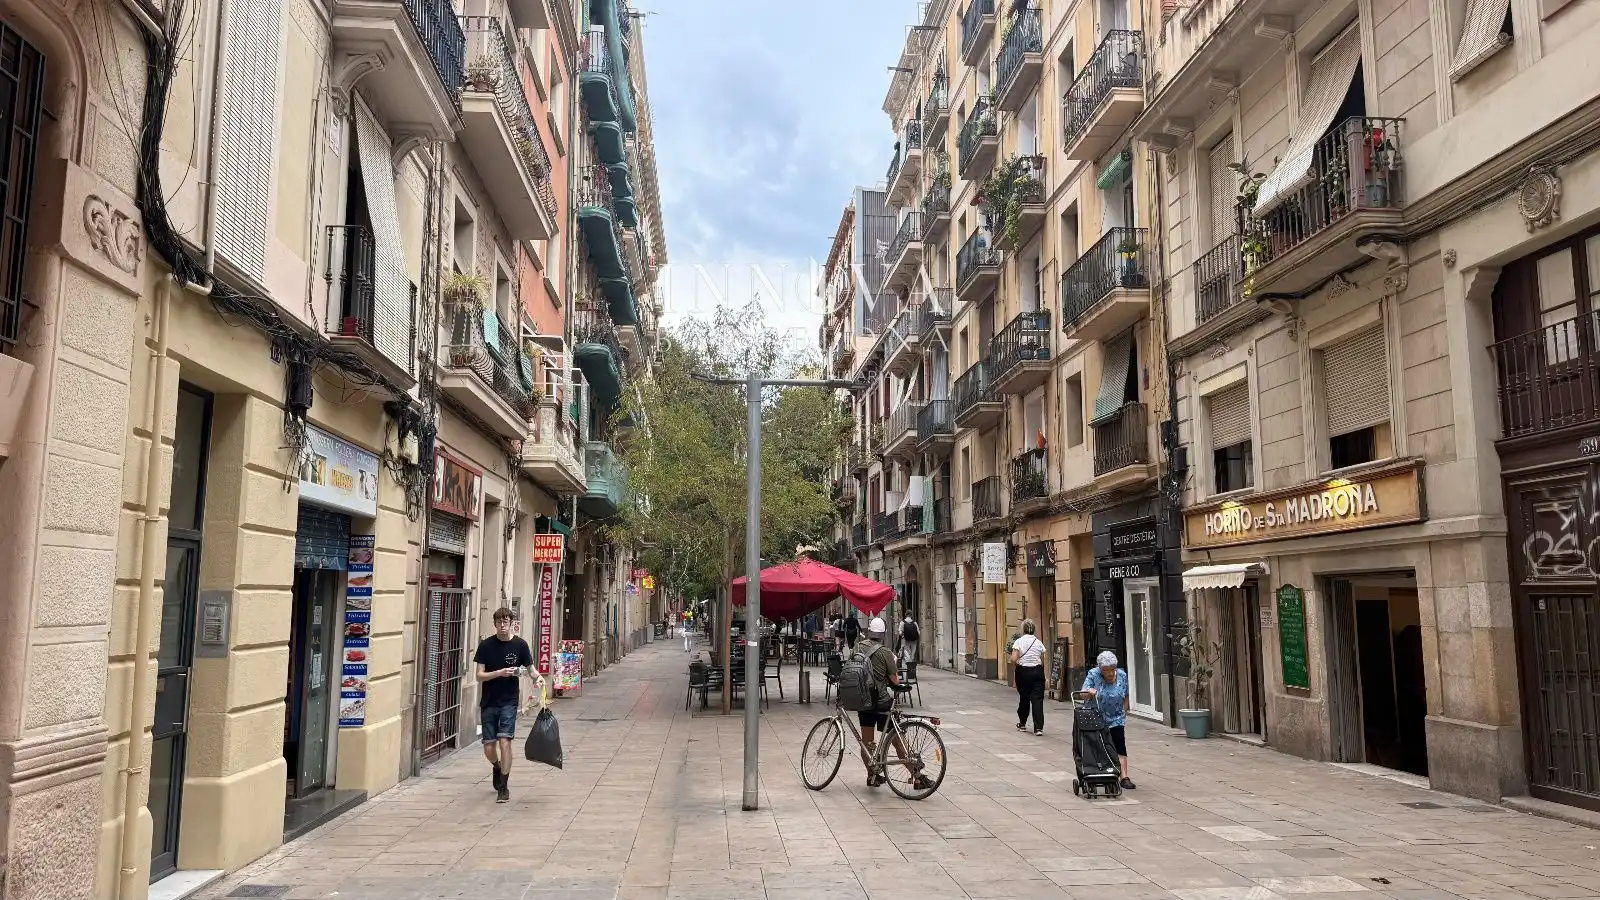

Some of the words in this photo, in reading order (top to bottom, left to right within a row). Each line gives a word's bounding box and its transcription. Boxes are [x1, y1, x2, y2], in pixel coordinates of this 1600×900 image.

[1205, 508, 1252, 535] HORNO
[1253, 516, 1265, 529] DE
[1286, 483, 1378, 524] MADRONA
[535, 536, 561, 547] SUPER
[534, 548, 561, 558] MERCAT
[1109, 566, 1125, 578] IRENE
[1126, 566, 1130, 577] &
[1131, 565, 1140, 577] CO
[540, 571, 553, 671] SUPERMERCAT
